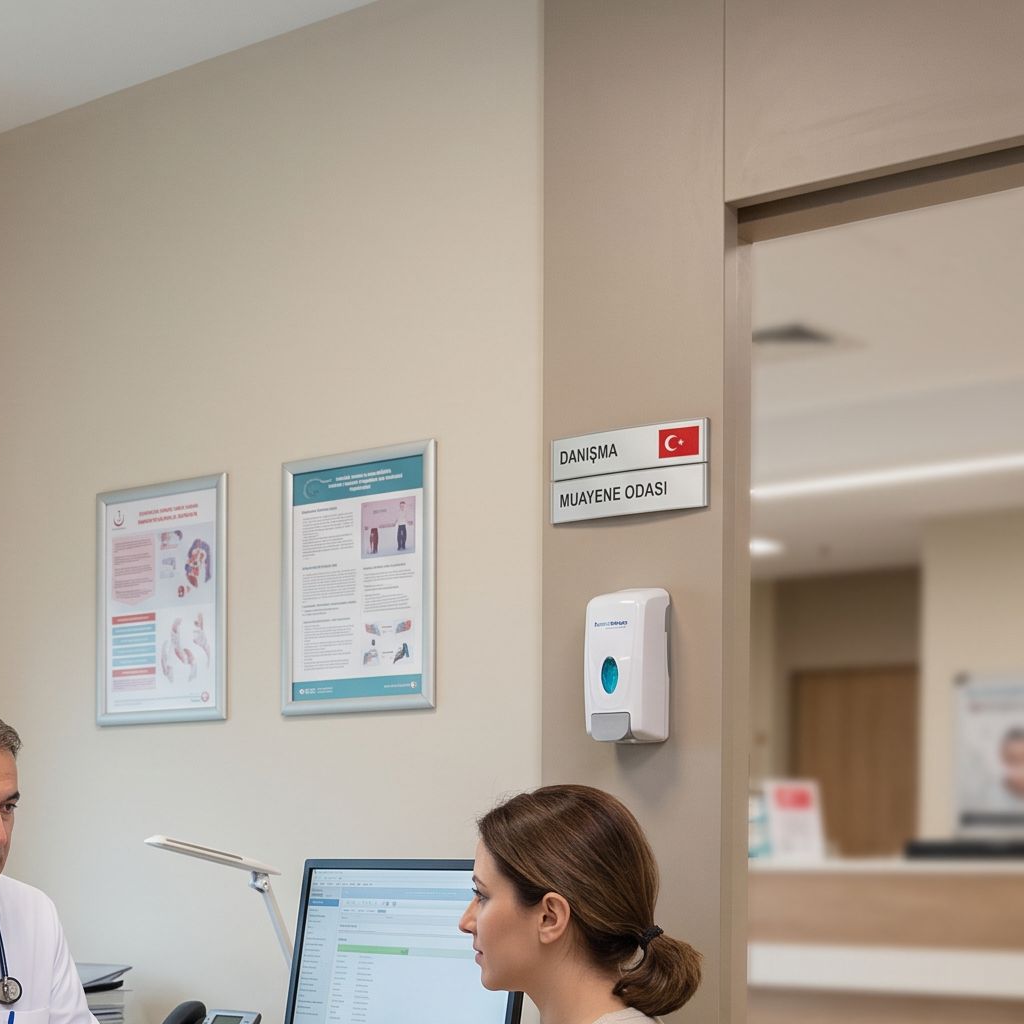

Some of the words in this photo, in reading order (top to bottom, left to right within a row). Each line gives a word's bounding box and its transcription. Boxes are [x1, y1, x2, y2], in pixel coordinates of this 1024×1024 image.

[559, 443, 618, 465] DANIŞMA
[559, 486, 621, 508] MUAYENE
[624, 481, 667, 499] ODASI
